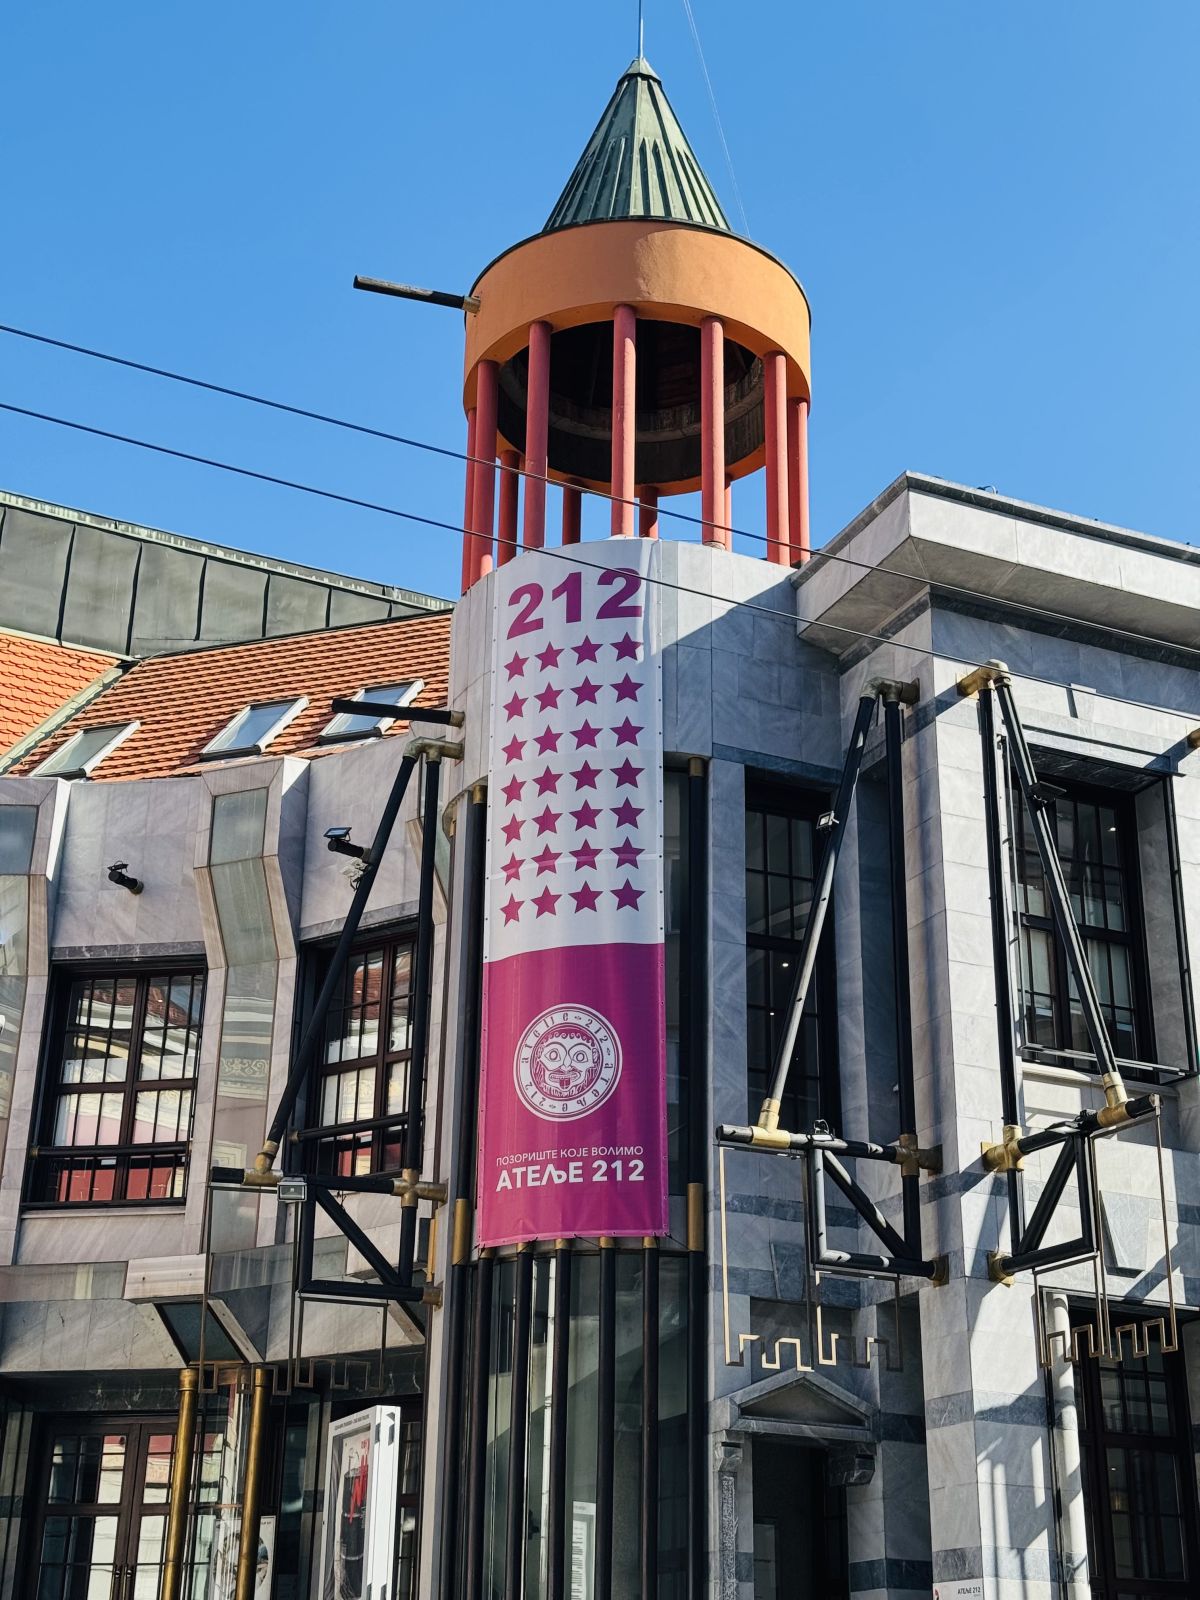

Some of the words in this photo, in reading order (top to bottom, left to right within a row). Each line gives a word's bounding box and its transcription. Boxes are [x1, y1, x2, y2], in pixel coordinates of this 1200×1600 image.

[506, 567, 643, 640] 212
[496, 1150, 558, 1167] ПОЗОРИШТЕ
[560, 1147, 589, 1159] КОЈЕ
[592, 1145, 644, 1156] ВОЛИМО
[495, 1161, 584, 1193] АТЕЉЕ
[591, 1159, 645, 1182] 212
